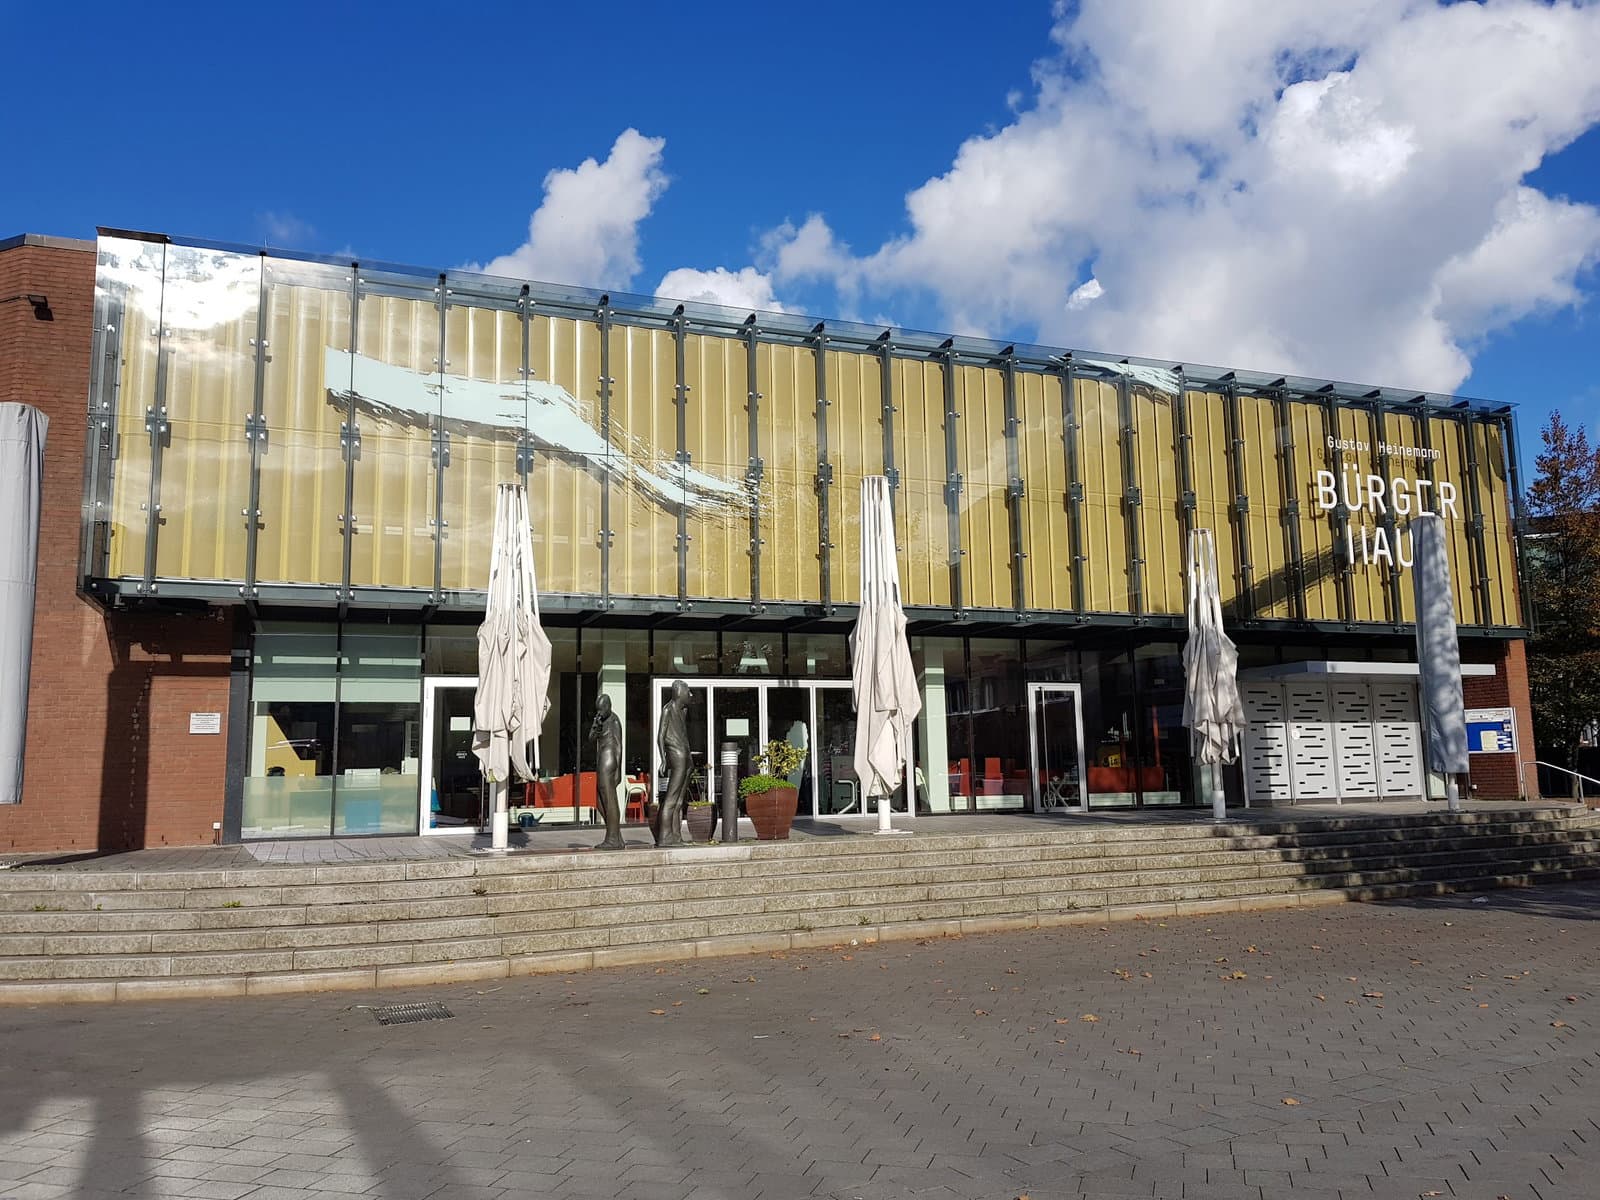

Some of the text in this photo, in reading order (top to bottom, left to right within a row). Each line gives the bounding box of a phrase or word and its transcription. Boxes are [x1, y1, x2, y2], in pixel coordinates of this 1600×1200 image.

[1327, 435, 1441, 460] Gustav Heinemann
[1317, 463, 1458, 520] BÜRGER
[1347, 523, 1414, 568] HAU
